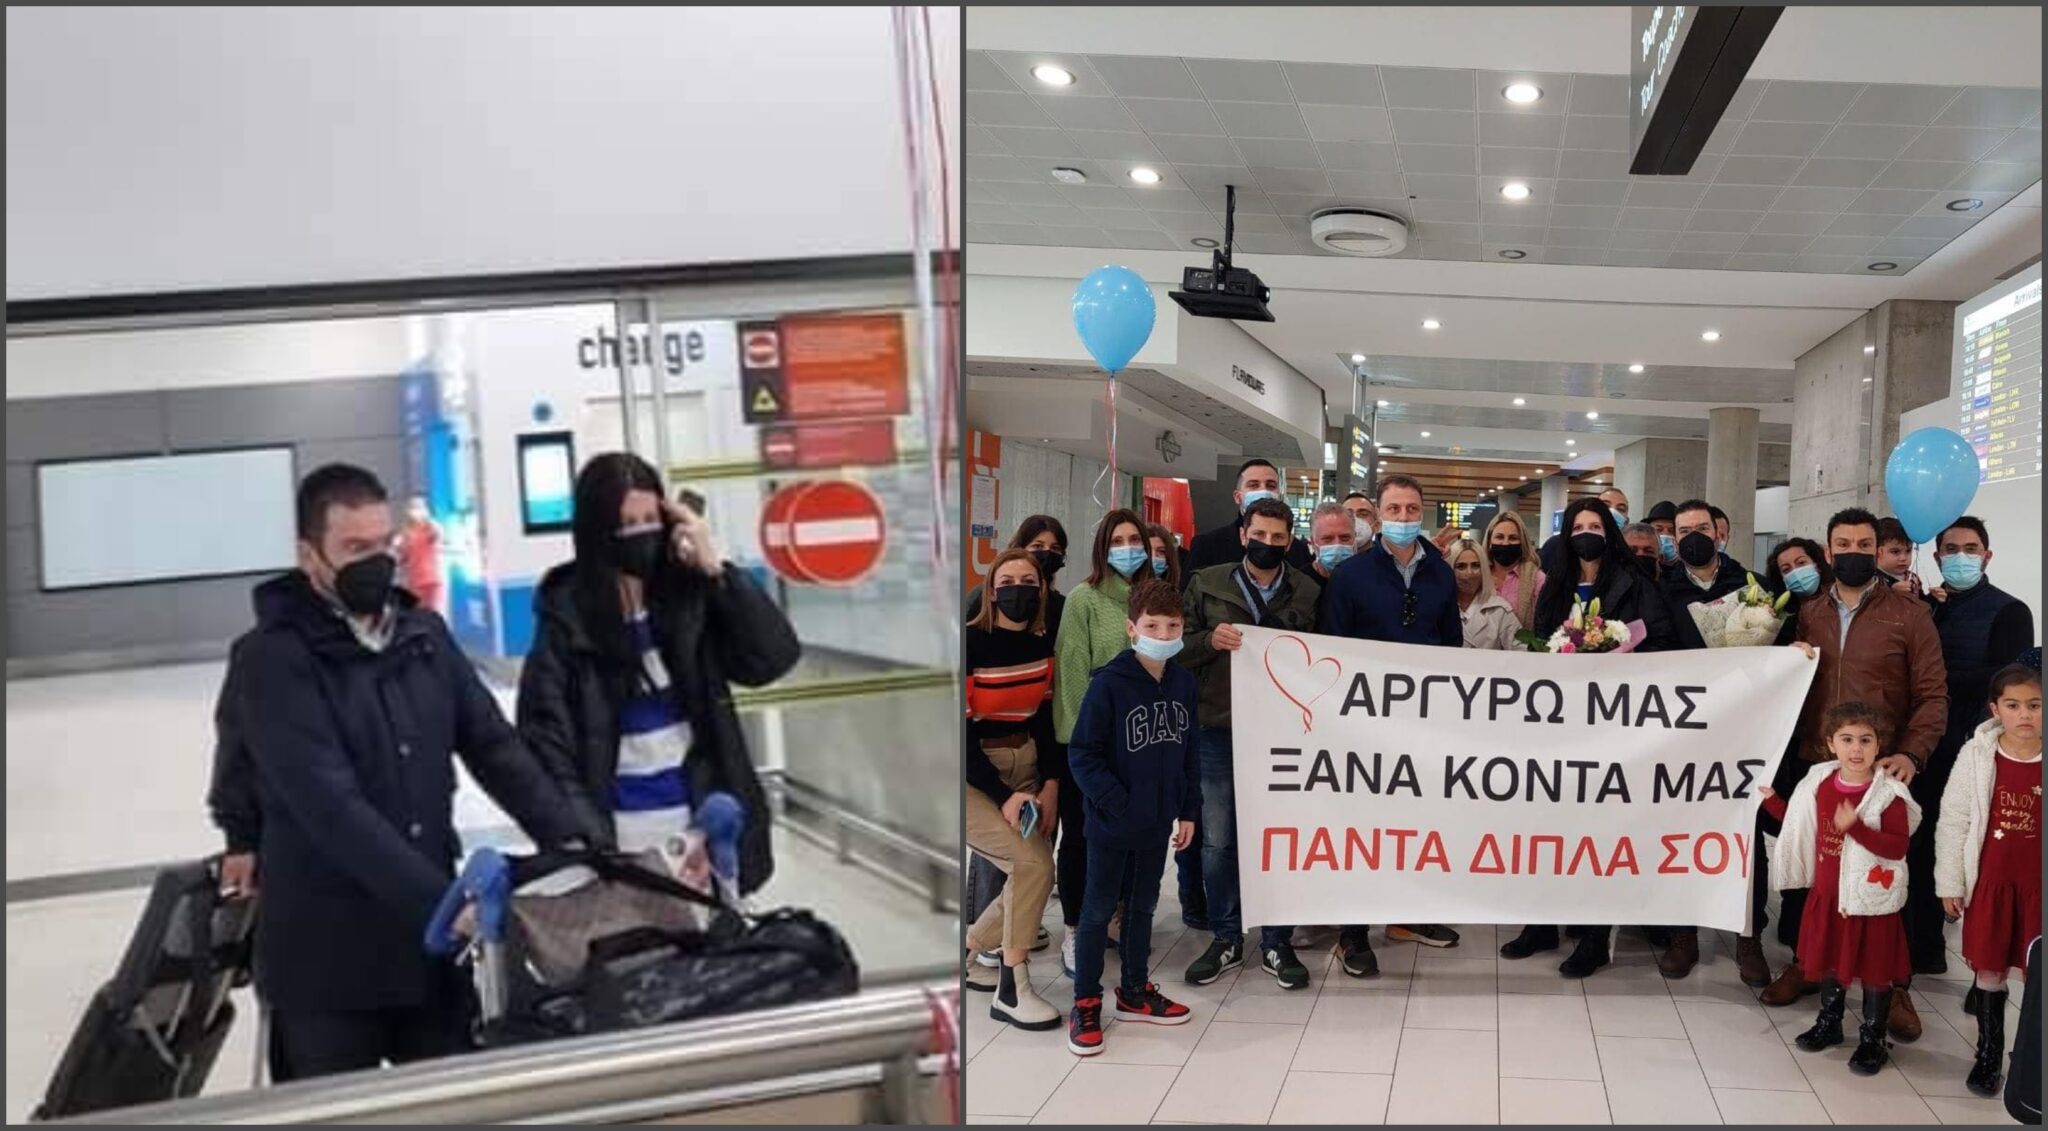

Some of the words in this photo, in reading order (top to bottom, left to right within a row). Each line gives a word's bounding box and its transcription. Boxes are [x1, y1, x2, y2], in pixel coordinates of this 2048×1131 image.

[1126, 701, 1189, 752] GAP
[1339, 672, 1565, 725] ΑΡΓΥΡΩ
[1586, 682, 1708, 730] ΜΑΣ
[1268, 747, 1423, 797] ΞΑΝΑ
[1443, 755, 1632, 804] ΚΟΝΤΑ
[1652, 758, 1766, 804] ΜΑΣ
[2000, 791, 2036, 809] ENJOY
[1261, 826, 1451, 874] ΠΑΝΤΑ
[1469, 835, 1640, 876] ΔΙΠΛΑ
[1656, 831, 1752, 879] ΣΟΥ
